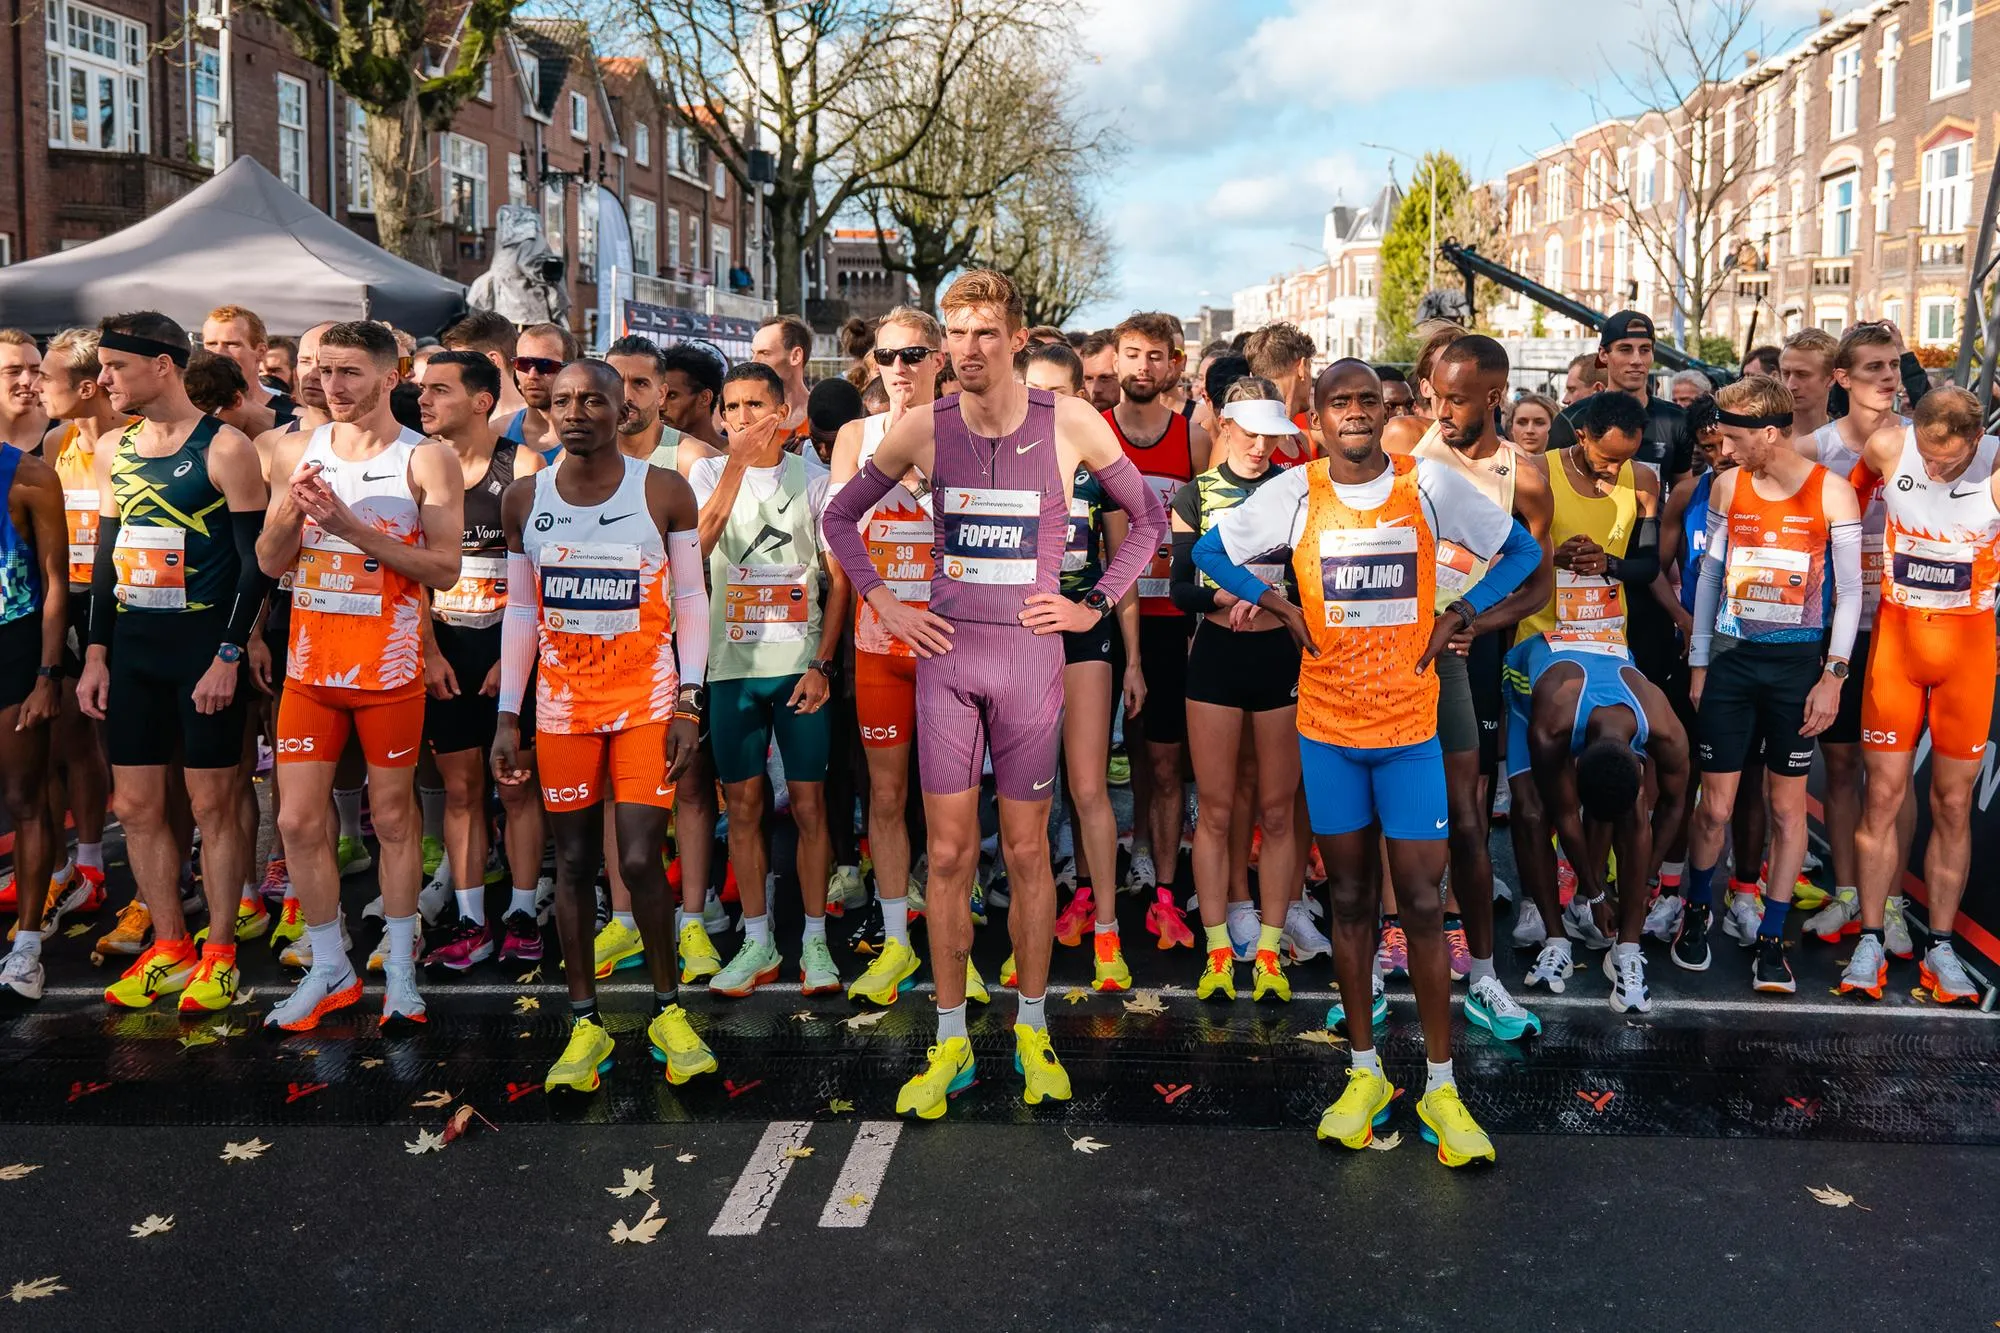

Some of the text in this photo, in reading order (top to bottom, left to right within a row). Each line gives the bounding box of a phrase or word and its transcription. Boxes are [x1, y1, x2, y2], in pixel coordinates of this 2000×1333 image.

[324, 465, 338, 473] NN
[1915, 482, 1928, 491] NN
[959, 493, 971, 509] 7
[80, 511, 89, 526] 6
[556, 517, 572, 525] NN
[314, 530, 323, 545] 7
[880, 524, 889, 538] 7
[957, 523, 1024, 549] FOPPEN
[895, 545, 915, 561] 39
[1906, 539, 1917, 551] 7
[138, 551, 148, 567] 5
[331, 554, 343, 571] 3
[556, 546, 569, 563] 7
[569, 553, 624, 562] Zevenheuvelenloop
[740, 567, 749, 581] 7
[886, 561, 926, 579] BJÖRN
[965, 567, 979, 575] NN
[1334, 563, 1405, 590] KIPLIMO
[1755, 569, 1775, 585] 28
[1906, 562, 1956, 585] DOUMA
[319, 571, 355, 592] MARC
[460, 579, 480, 594] 35
[544, 576, 637, 601] KIPLANGAT
[314, 597, 326, 605] NN
[757, 587, 773, 603] 12
[1585, 589, 1600, 603] 54
[1746, 584, 1784, 602] FRANK
[1910, 593, 1922, 601] NN
[743, 604, 789, 621] YACOUB
[1347, 610, 1361, 618] NN
[1374, 602, 1414, 624] 2024
[566, 618, 580, 626] NN
[594, 612, 635, 633] 2024
